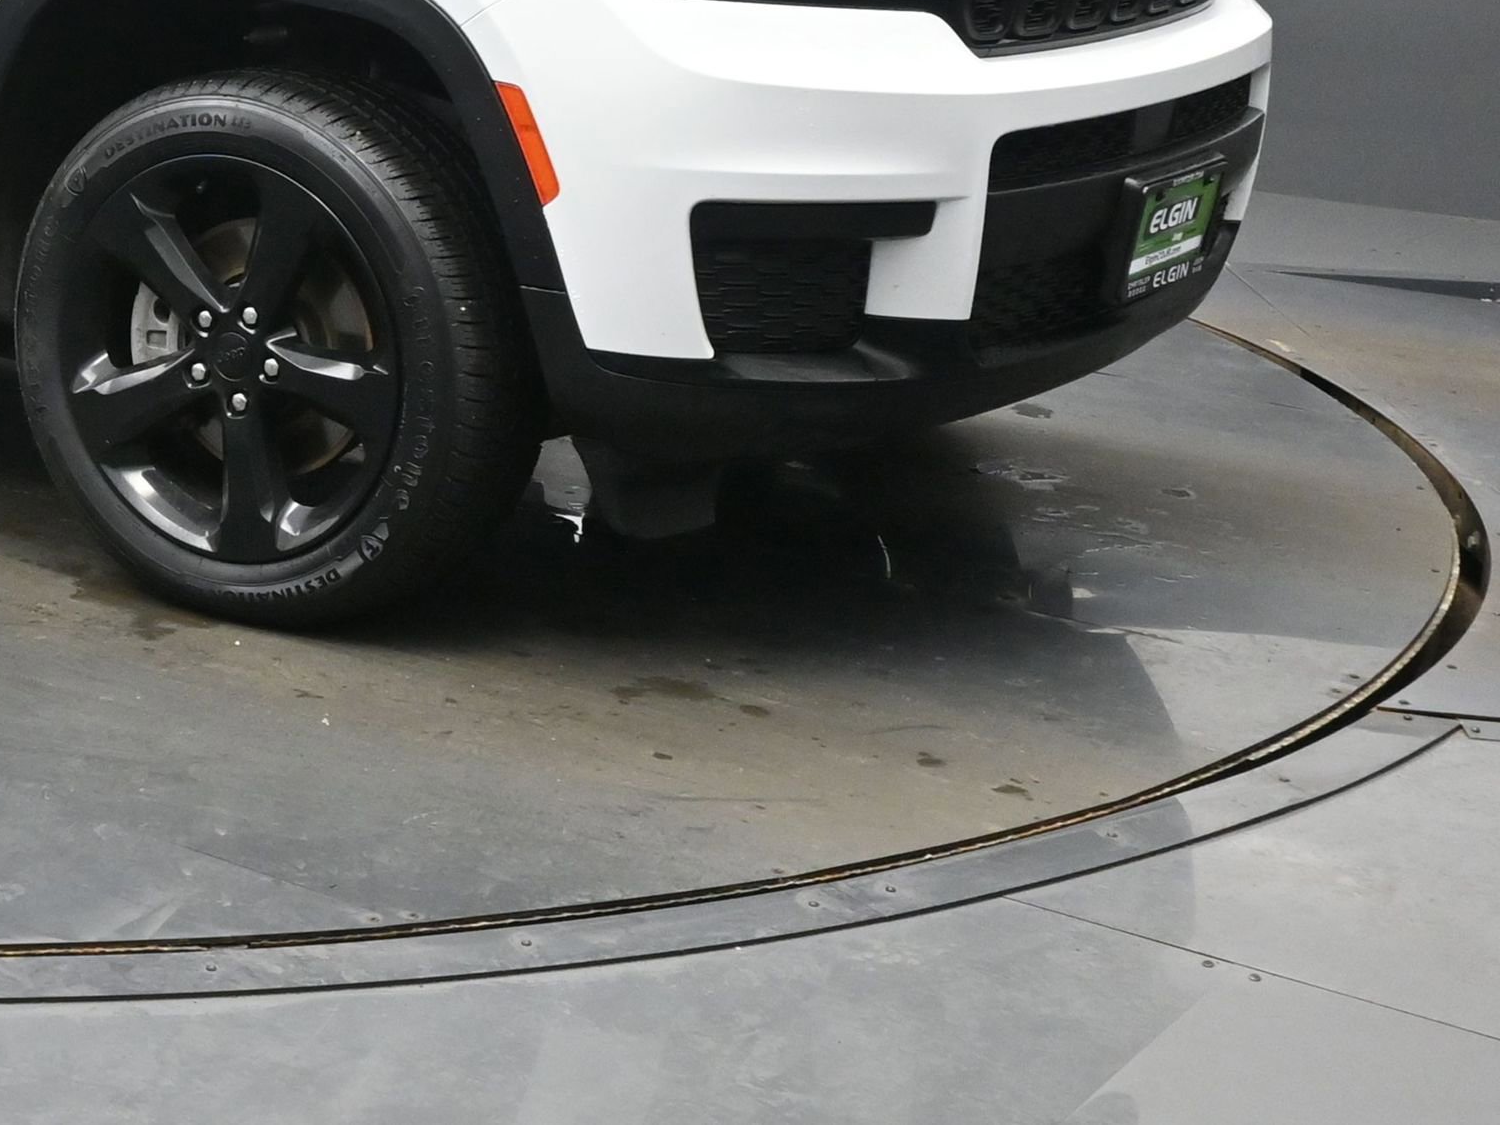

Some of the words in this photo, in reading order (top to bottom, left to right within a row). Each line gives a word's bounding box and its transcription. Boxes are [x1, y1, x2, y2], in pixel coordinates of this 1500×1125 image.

[104, 113, 227, 159] DESTINATION
[1150, 197, 1198, 234] ELGIN
[1153, 261, 1189, 288] ELGIN
